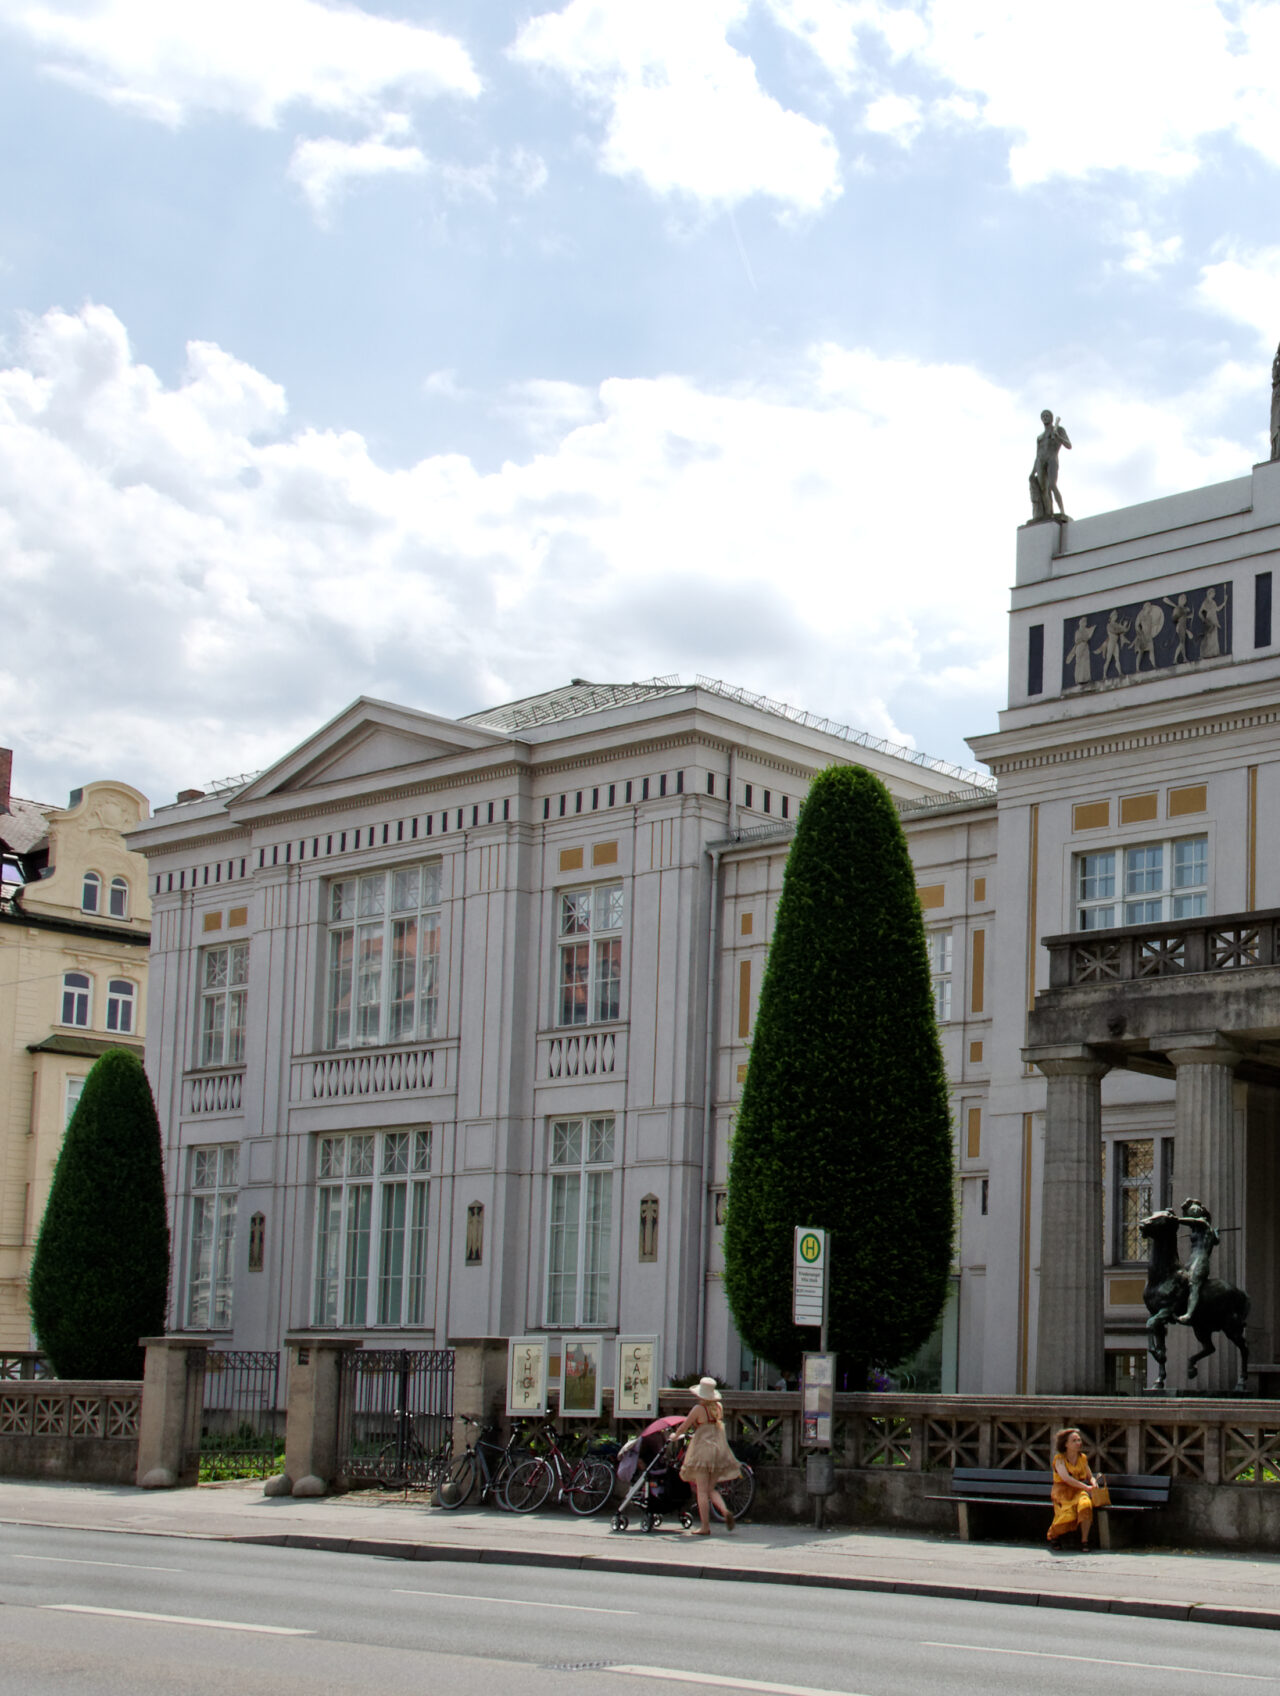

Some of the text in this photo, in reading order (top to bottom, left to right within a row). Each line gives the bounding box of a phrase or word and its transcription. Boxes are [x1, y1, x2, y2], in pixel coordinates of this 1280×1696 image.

[806, 1240, 815, 1257] H
[522, 1348, 533, 1403] SHOP
[632, 1347, 641, 1405] CAFE
